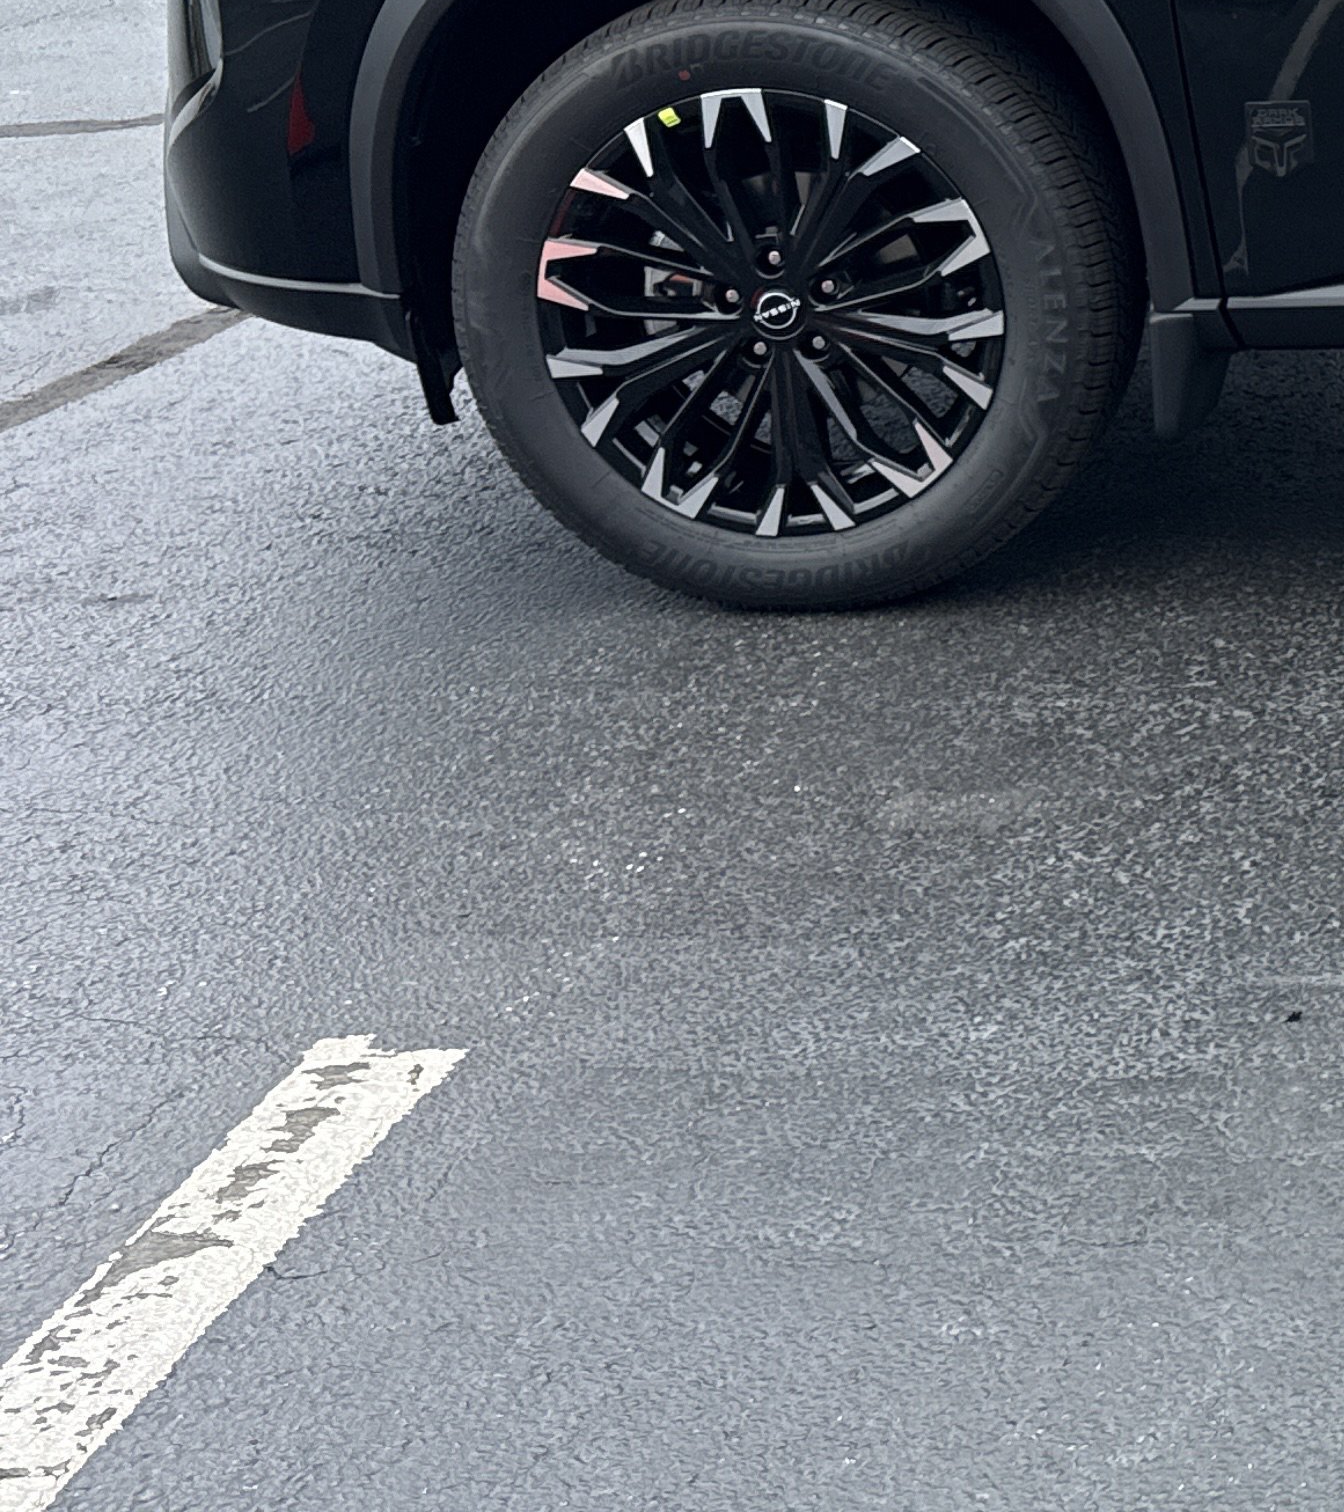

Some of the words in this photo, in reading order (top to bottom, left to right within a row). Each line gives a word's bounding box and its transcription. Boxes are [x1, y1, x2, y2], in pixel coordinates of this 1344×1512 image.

[612, 29, 897, 92] BRIDGESTONE
[1257, 108, 1298, 118] DARK
[752, 296, 801, 322] NISSAN
[1028, 239, 1070, 402] ALENZA
